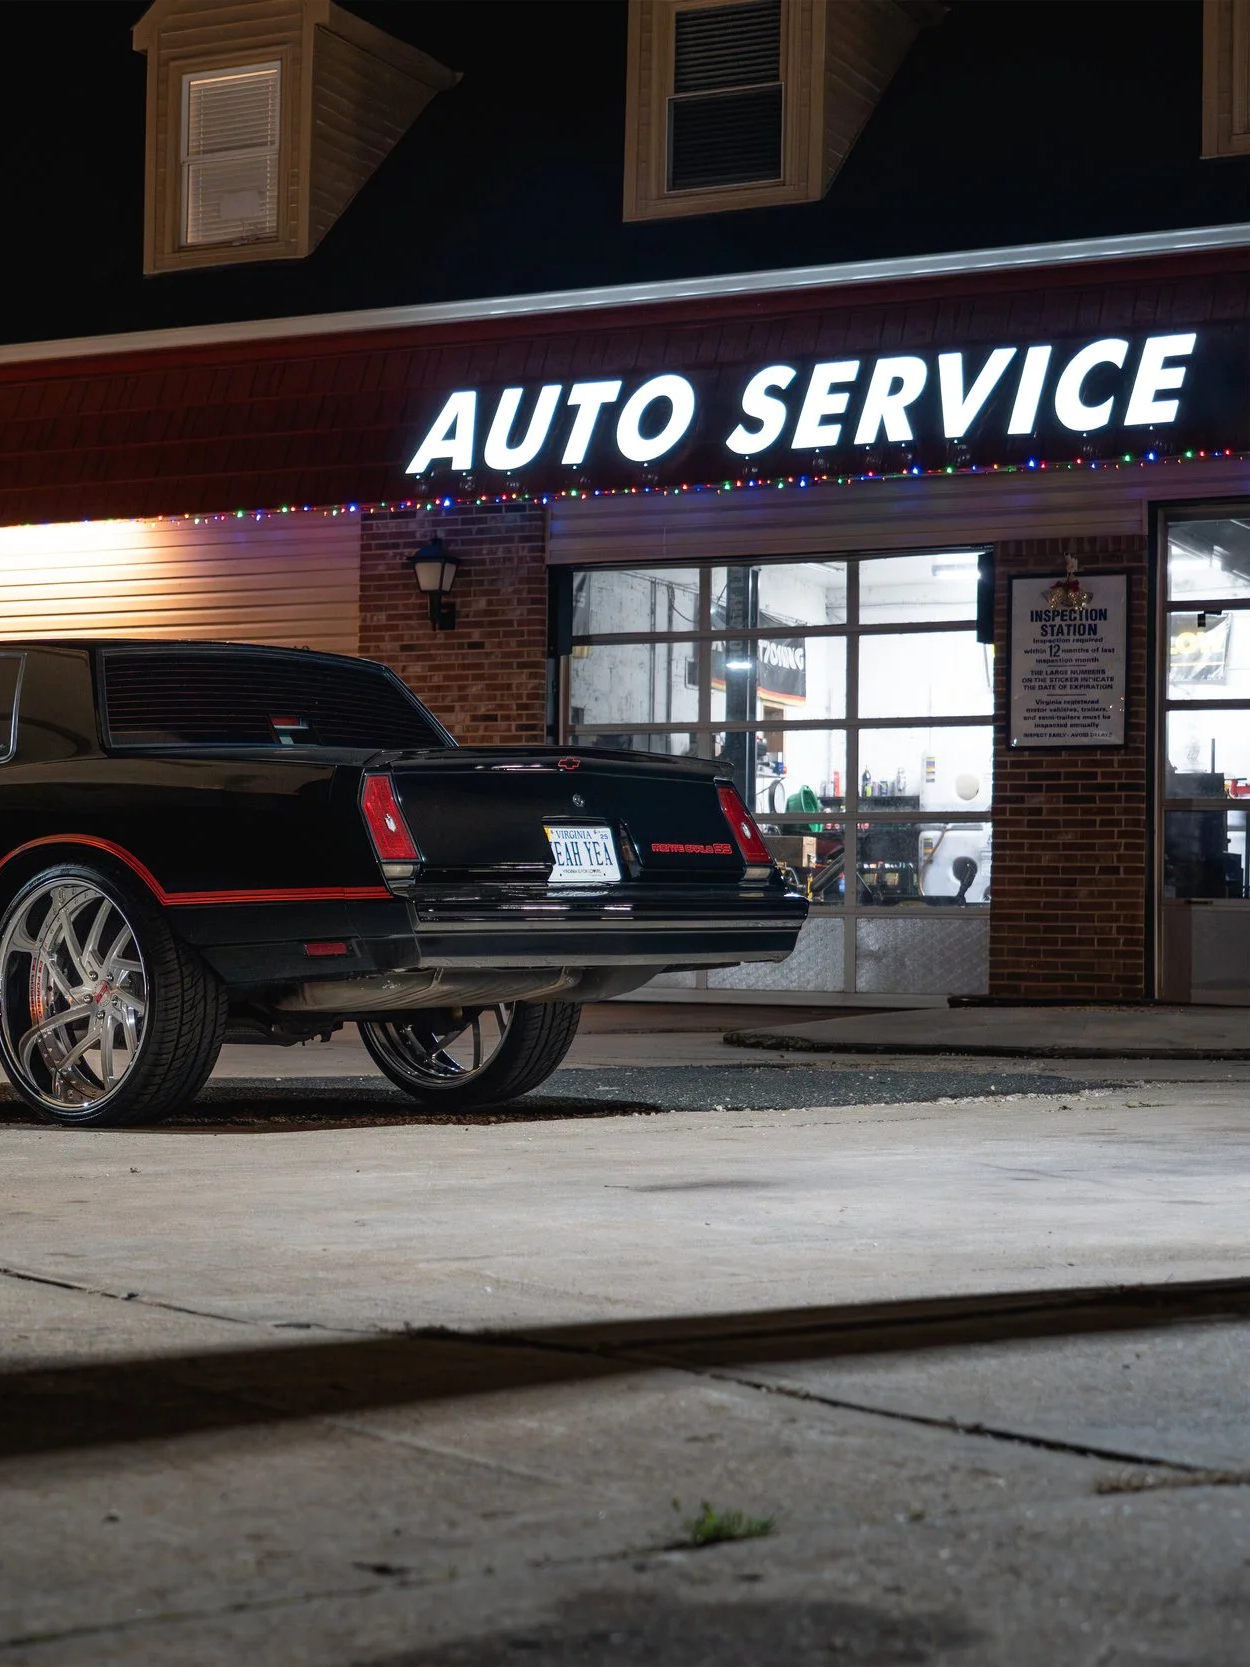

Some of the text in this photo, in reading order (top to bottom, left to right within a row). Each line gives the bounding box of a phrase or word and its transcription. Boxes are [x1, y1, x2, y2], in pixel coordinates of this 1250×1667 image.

[405, 333, 1197, 474] AUTO SERVICE
[1030, 608, 1107, 622] INSPECTION
[1040, 624, 1098, 637] STATION
[1072, 637, 1103, 645] required
[1048, 644, 1061, 658] 12
[555, 830, 592, 839] VIRGINIA
[549, 841, 614, 866] EAH YEA
[712, 843, 733, 854] SS
